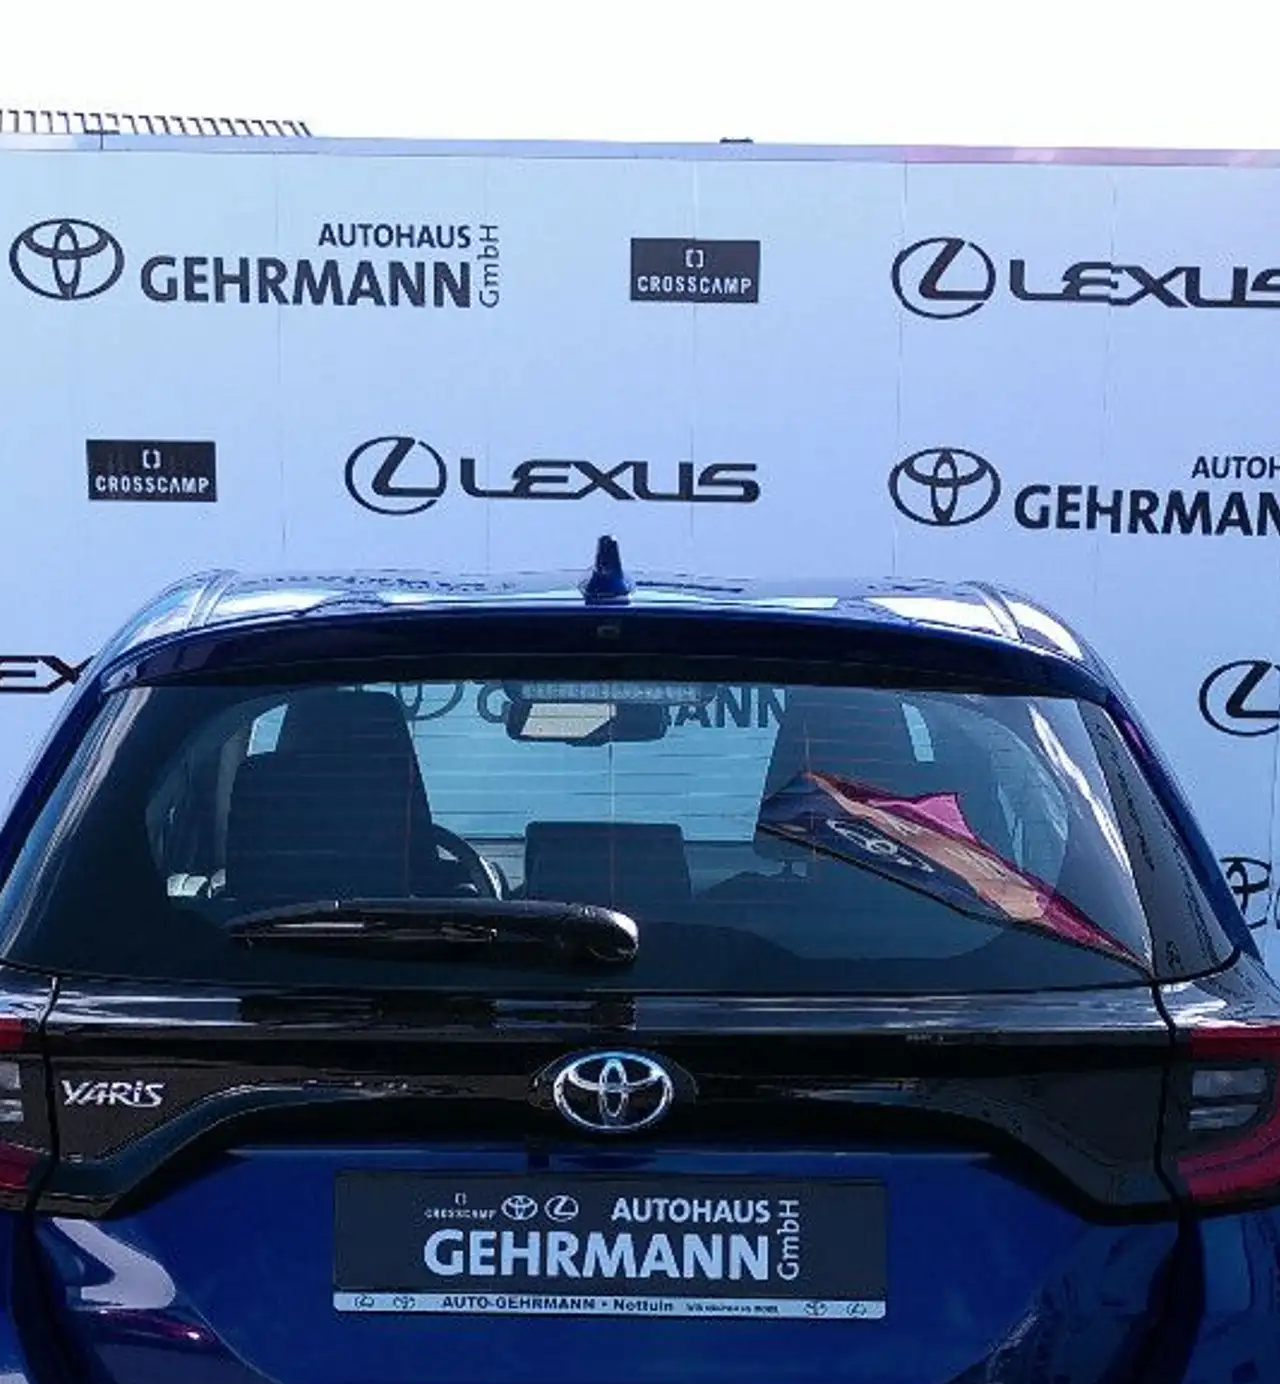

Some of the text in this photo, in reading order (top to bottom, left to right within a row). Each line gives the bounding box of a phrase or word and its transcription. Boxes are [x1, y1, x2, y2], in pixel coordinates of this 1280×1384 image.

[319, 224, 470, 248] AUTOHAUS
[141, 256, 470, 308] GEHRMANN
[477, 225, 499, 308] GmbH
[638, 276, 751, 293] CROSSCAMP
[96, 476, 209, 493] CROSSCAMP
[460, 458, 760, 503] LEXUS
[611, 1198, 770, 1223] AUTOHAUS
[424, 1229, 768, 1280] GEHRMANN
[777, 1200, 799, 1280] GmbH
